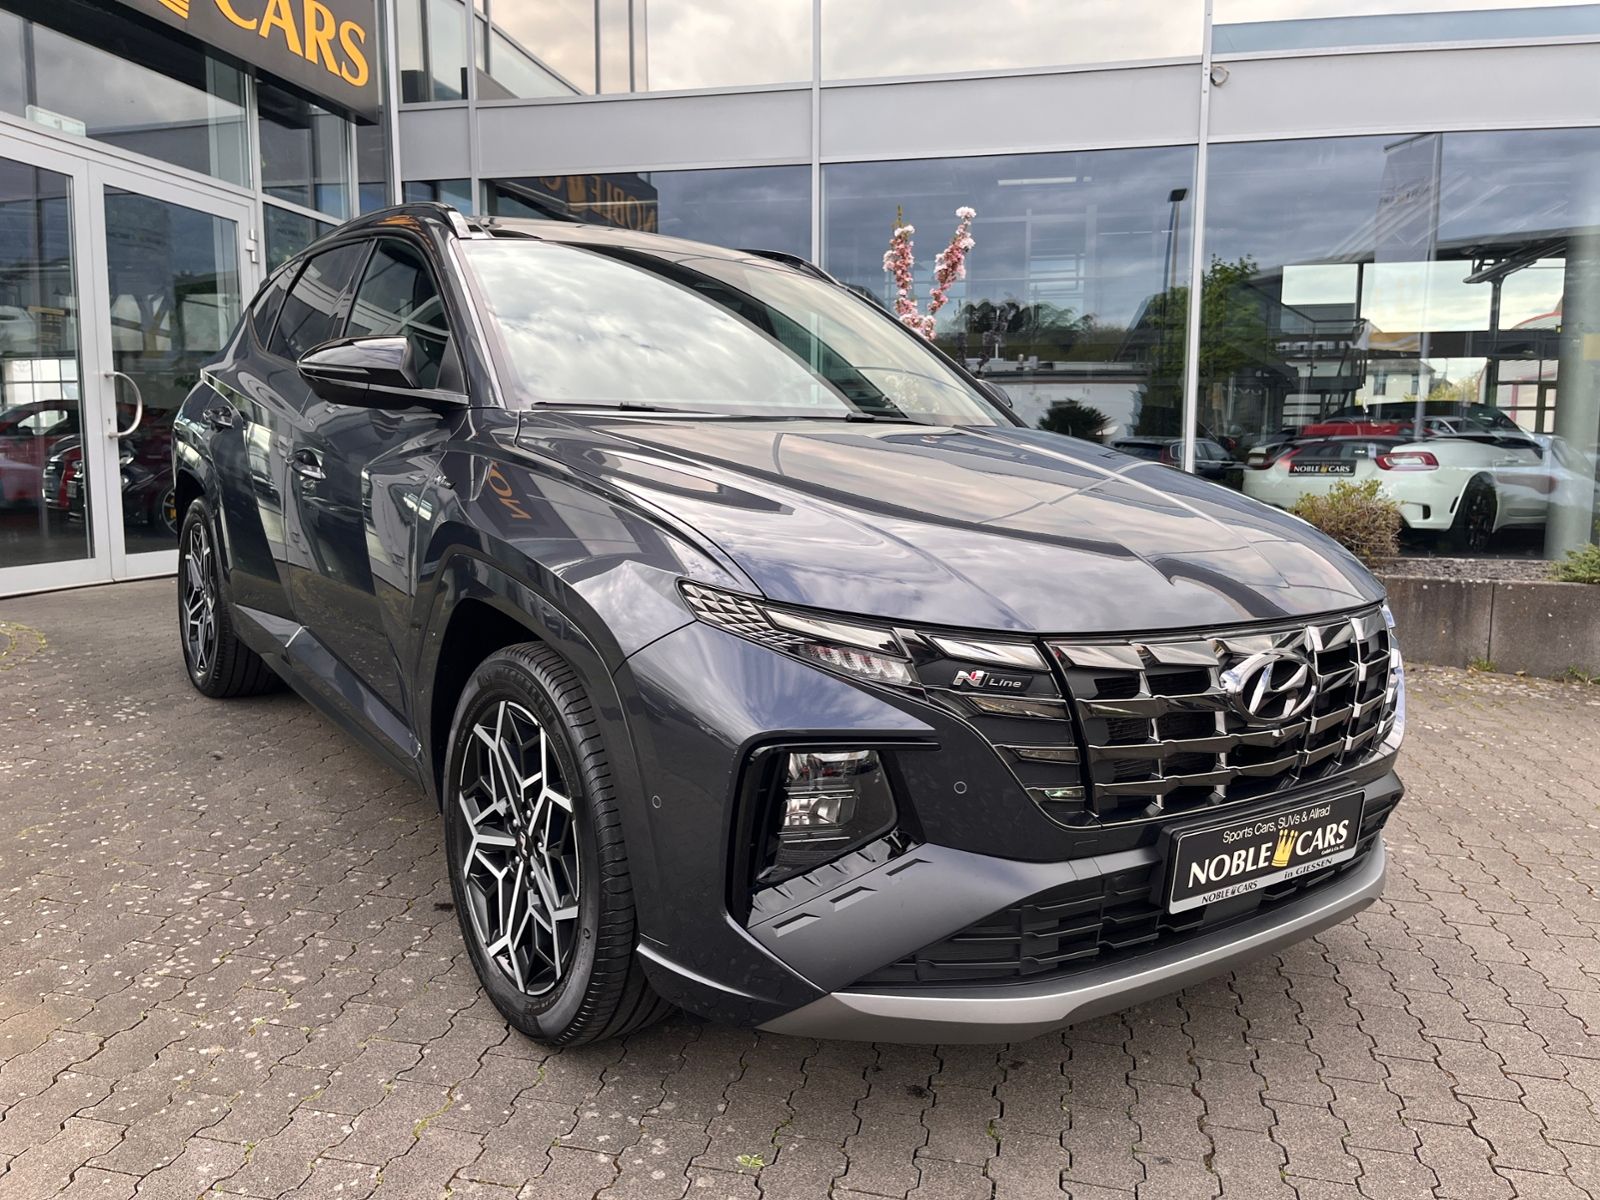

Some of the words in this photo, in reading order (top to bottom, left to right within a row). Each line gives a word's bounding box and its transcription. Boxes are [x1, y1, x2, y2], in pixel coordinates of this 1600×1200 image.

[953, 670, 987, 687] N
[989, 678, 1022, 688] Line
[1222, 826, 1253, 844] Sports
[1254, 822, 1277, 836] Cars,
[1277, 814, 1300, 829] SUVs
[1301, 811, 1308, 822] &
[1309, 804, 1331, 820] Allrad
[1188, 842, 1272, 888] NOBLE
[1296, 820, 1349, 856] CARS
[1201, 888, 1230, 904] NOBLE
[1237, 880, 1258, 894] CARS
[1284, 871, 1293, 879] in
[1295, 858, 1333, 875] GIESSEN
